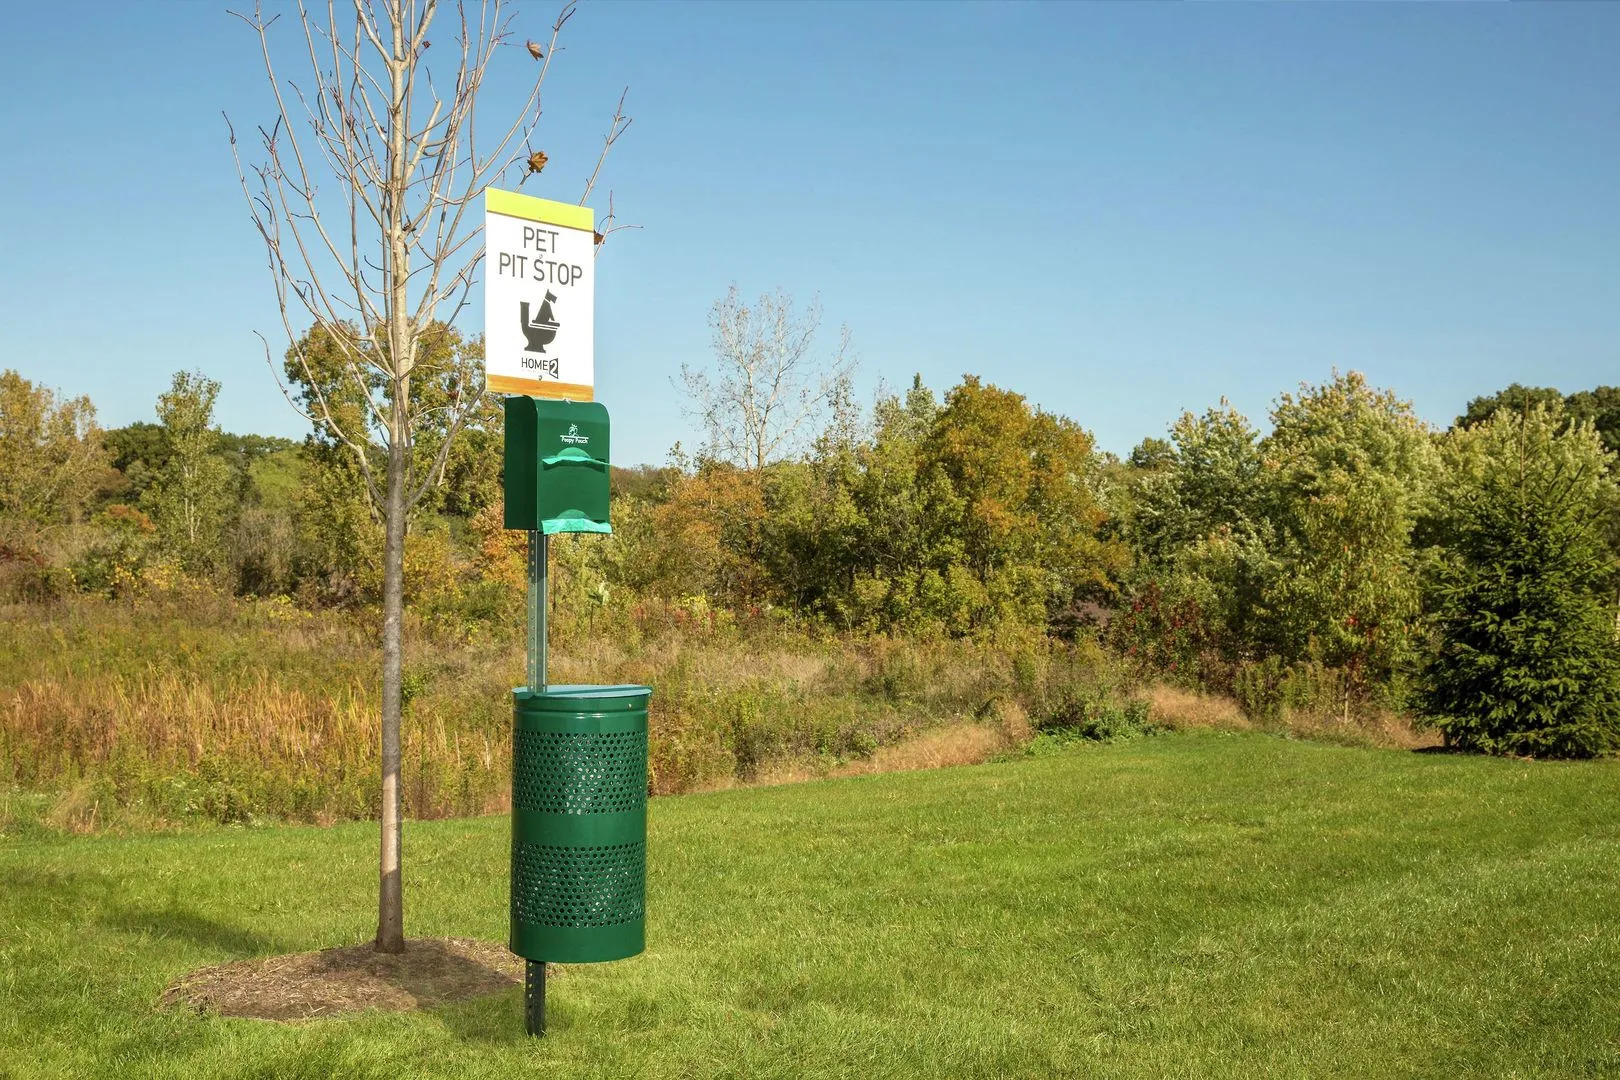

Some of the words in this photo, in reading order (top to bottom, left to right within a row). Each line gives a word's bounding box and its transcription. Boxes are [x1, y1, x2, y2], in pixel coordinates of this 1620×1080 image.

[523, 226, 559, 254] PET
[499, 252, 528, 279] PIT
[533, 258, 583, 287] STOP
